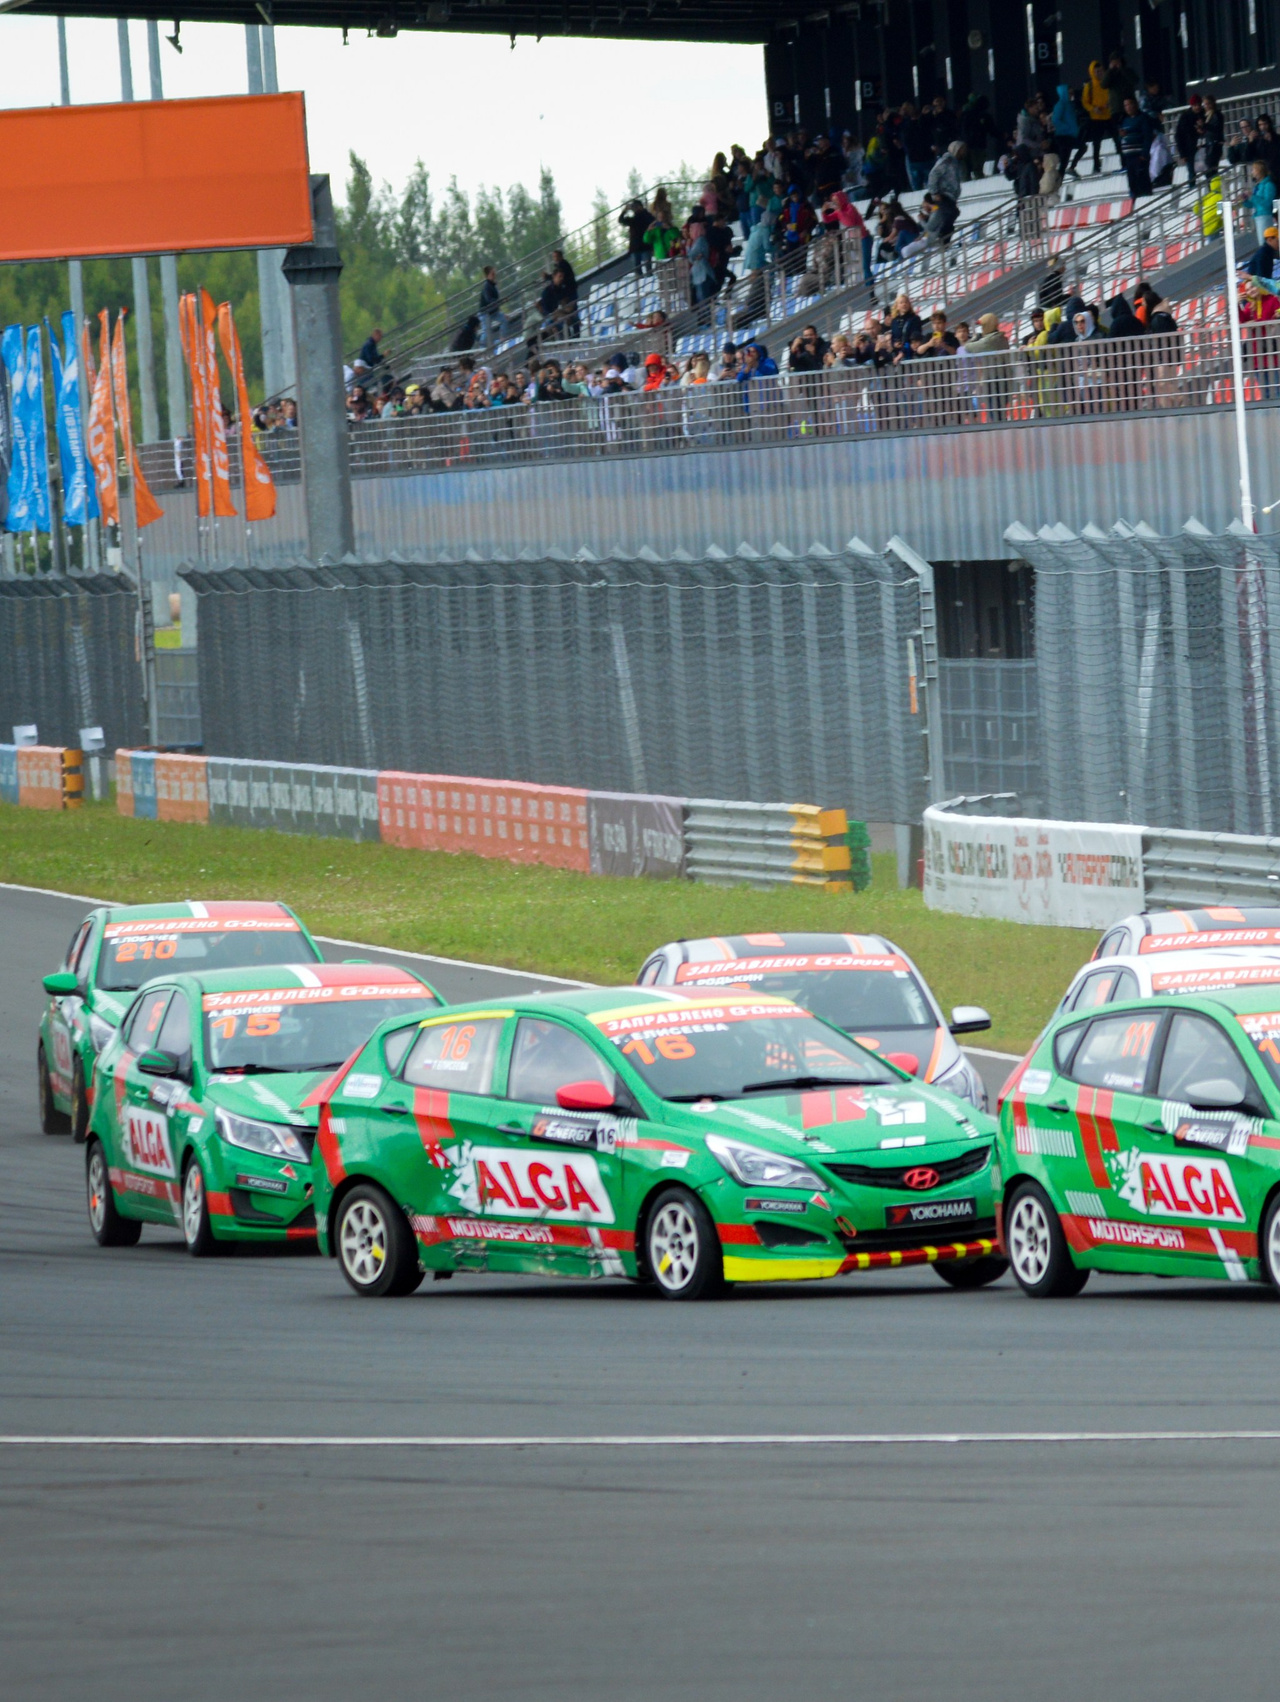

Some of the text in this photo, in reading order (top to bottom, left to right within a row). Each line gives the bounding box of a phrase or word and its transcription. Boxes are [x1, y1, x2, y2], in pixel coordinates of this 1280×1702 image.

[1150, 931, 1268, 948] ЗАПРАВЛЕНО
[115, 941, 177, 962] 210
[685, 957, 807, 977] ЗАПРАВЛЕНО
[206, 988, 334, 1007] ЗАПРАВЛЕНО
[211, 1013, 281, 1039] 15
[607, 1010, 725, 1032] ЗАПРАВЛЕНО
[439, 1025, 477, 1061] 16
[622, 1034, 696, 1066] 16
[1121, 1021, 1156, 1058] 111
[129, 1118, 171, 1169] ALGA
[598, 1128, 616, 1145] 16
[1231, 1128, 1250, 1147] 111
[477, 1160, 602, 1214] ALGA
[1140, 1162, 1243, 1218] ALGA
[759, 1200, 804, 1212] YOKOHAMA
[910, 1201, 973, 1221] YOKOHAMA
[448, 1220, 555, 1243] MOTORSPORT
[1088, 1219, 1185, 1249] MOTORSPORT
